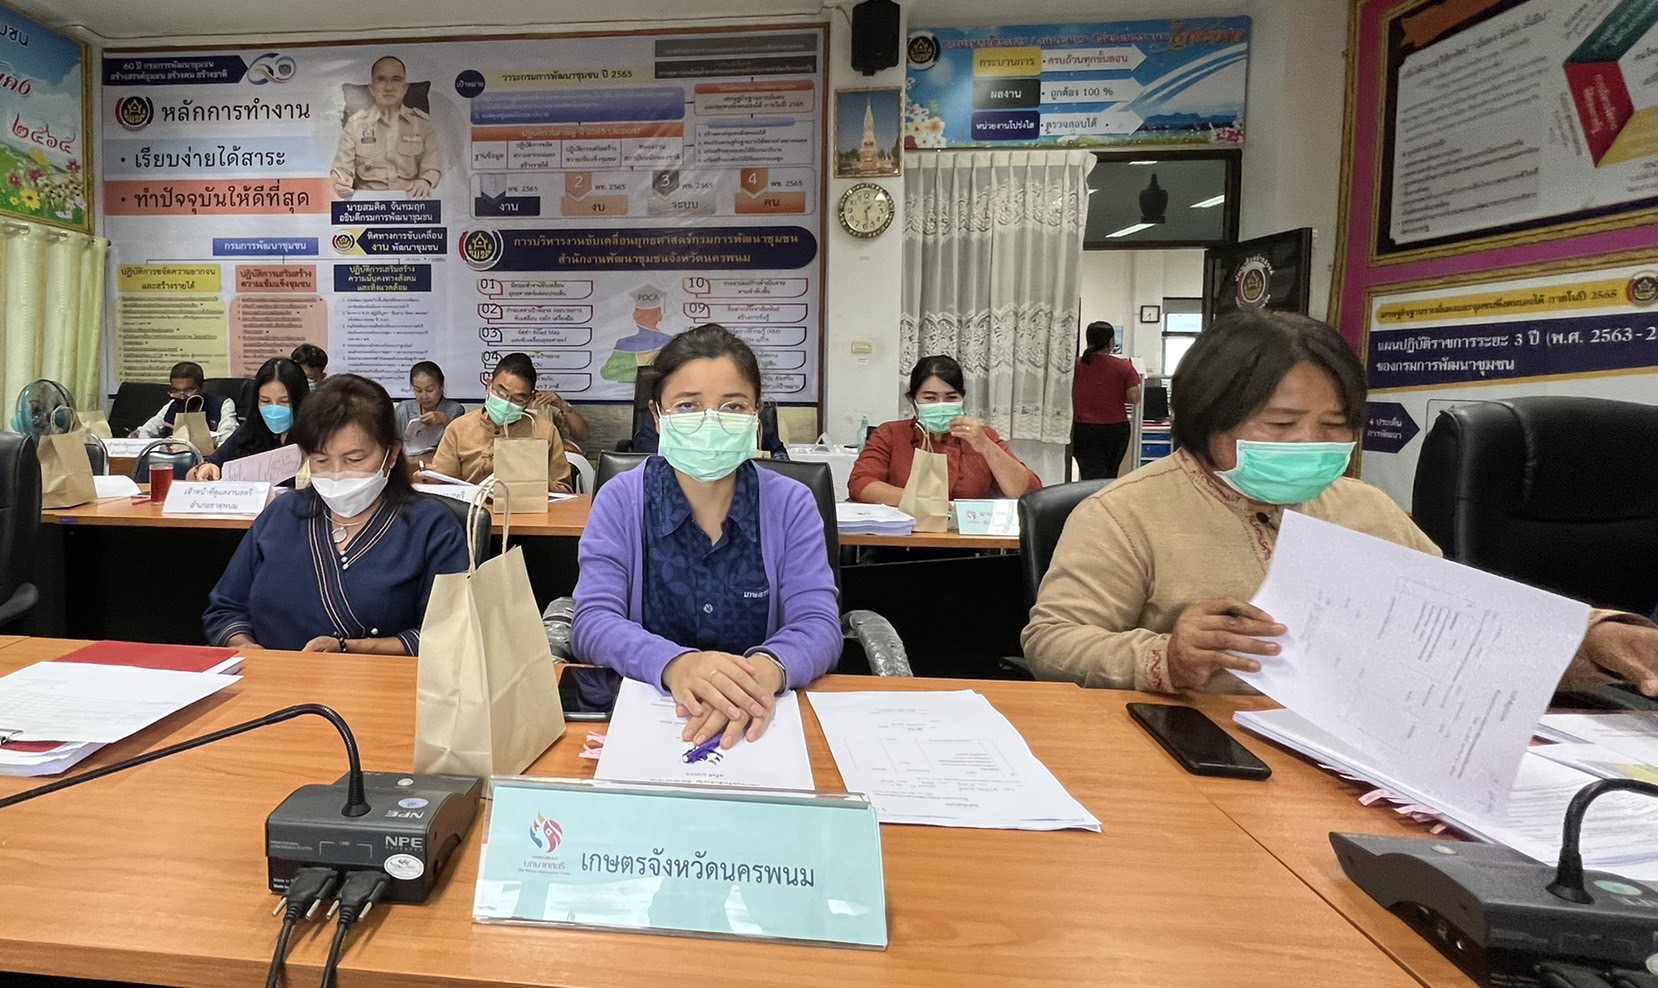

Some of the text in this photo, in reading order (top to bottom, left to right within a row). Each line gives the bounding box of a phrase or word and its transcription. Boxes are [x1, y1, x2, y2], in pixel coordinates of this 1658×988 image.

[979, 58, 1035, 68] กระบวนการ
[502, 70, 632, 82] วาระกรมการพัฒนาชุมชน ปี 2565
[990, 88, 1022, 99] ผลงาน
[1050, 86, 1079, 100] ถูกต้อง
[1083, 88, 1100, 97] 100
[161, 97, 310, 122] หลักการทำงาน
[976, 120, 1035, 130] หน่วยงานโปร่งใส
[134, 145, 286, 168] เรียบง่ายได้สาระ
[575, 177, 583, 188] 2
[661, 174, 670, 187] 3
[748, 172, 757, 185] 4
[785, 179, 803, 187] 2565
[608, 182, 626, 191] 2565
[134, 179, 310, 214] ทำปัจจุบันให้ดีที่สุด
[499, 202, 519, 212] งาน
[591, 203, 605, 212] งบ
[672, 200, 699, 209] ระบบ
[224, 240, 307, 253] กรมการพัฒนาชุมชน
[371, 242, 438, 254] งาน พัฒนาชุมชน
[558, 251, 751, 267] สำนักงานพัฒนาชุมชนจังหวัดนครพนม
[480, 279, 496, 289] 01
[689, 277, 705, 288] 10
[1590, 289, 1617, 300] 2565
[481, 304, 498, 314] 02
[689, 302, 706, 314] 09
[482, 328, 498, 338] 03
[1378, 335, 1509, 353] แผนปฏิบัติราชการระยะ
[1514, 333, 1523, 346] 3
[1527, 329, 1540, 346] ปี
[1546, 331, 1583, 347] (พ.ศ.
[483, 351, 498, 361] 04
[1376, 356, 1515, 376] ของกรมการพัฒนาชุมชน
[385, 836, 423, 848] NPE
[581, 848, 816, 888] เกษตรจังหวัดนครพนม
